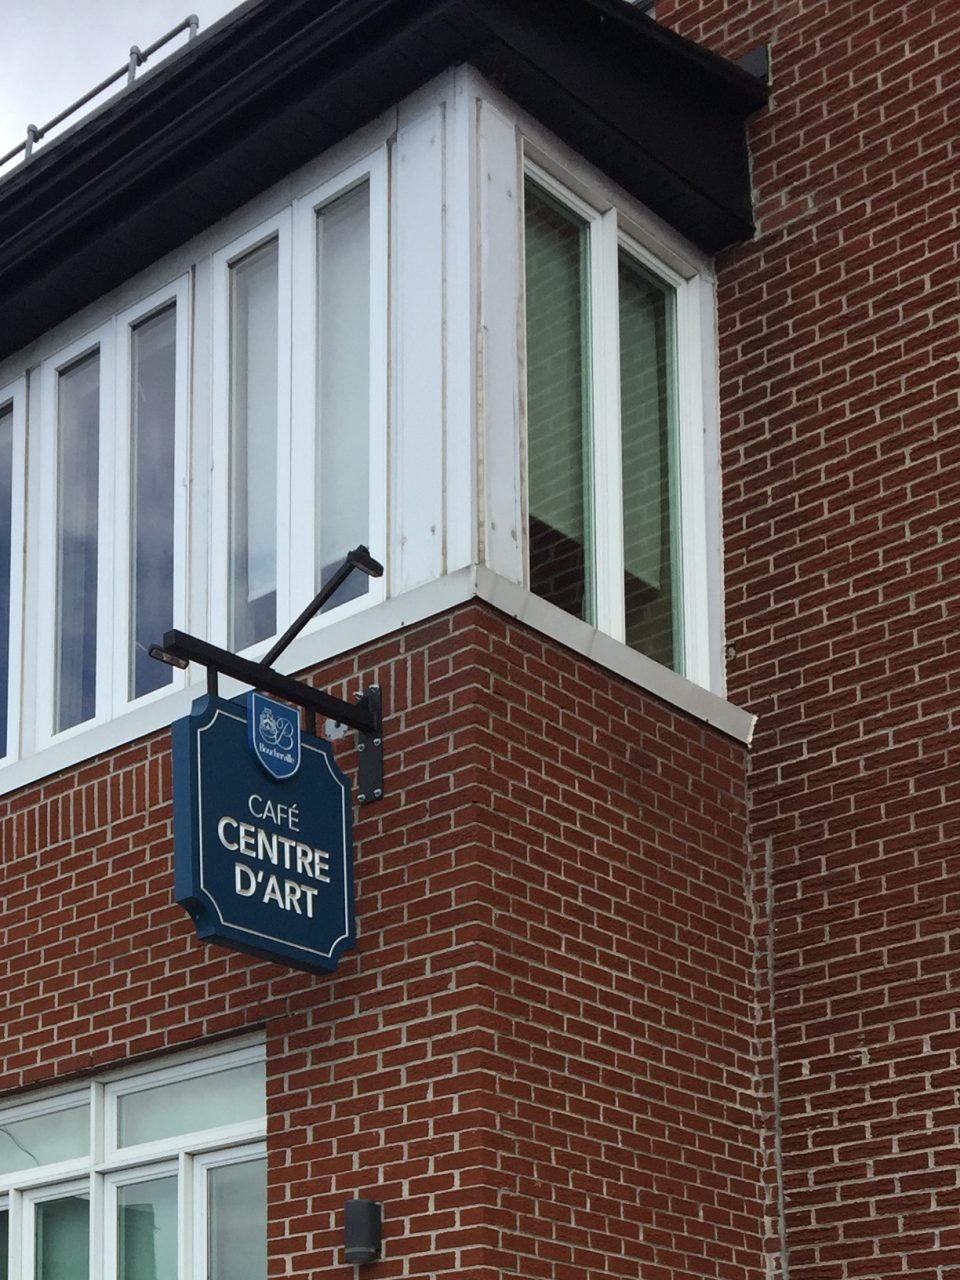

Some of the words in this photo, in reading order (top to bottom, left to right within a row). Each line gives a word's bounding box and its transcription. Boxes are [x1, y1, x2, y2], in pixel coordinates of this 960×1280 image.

[248, 794, 300, 832] CAFÉ
[217, 816, 331, 884] CENTRE
[234, 862, 319, 918] D'ART
